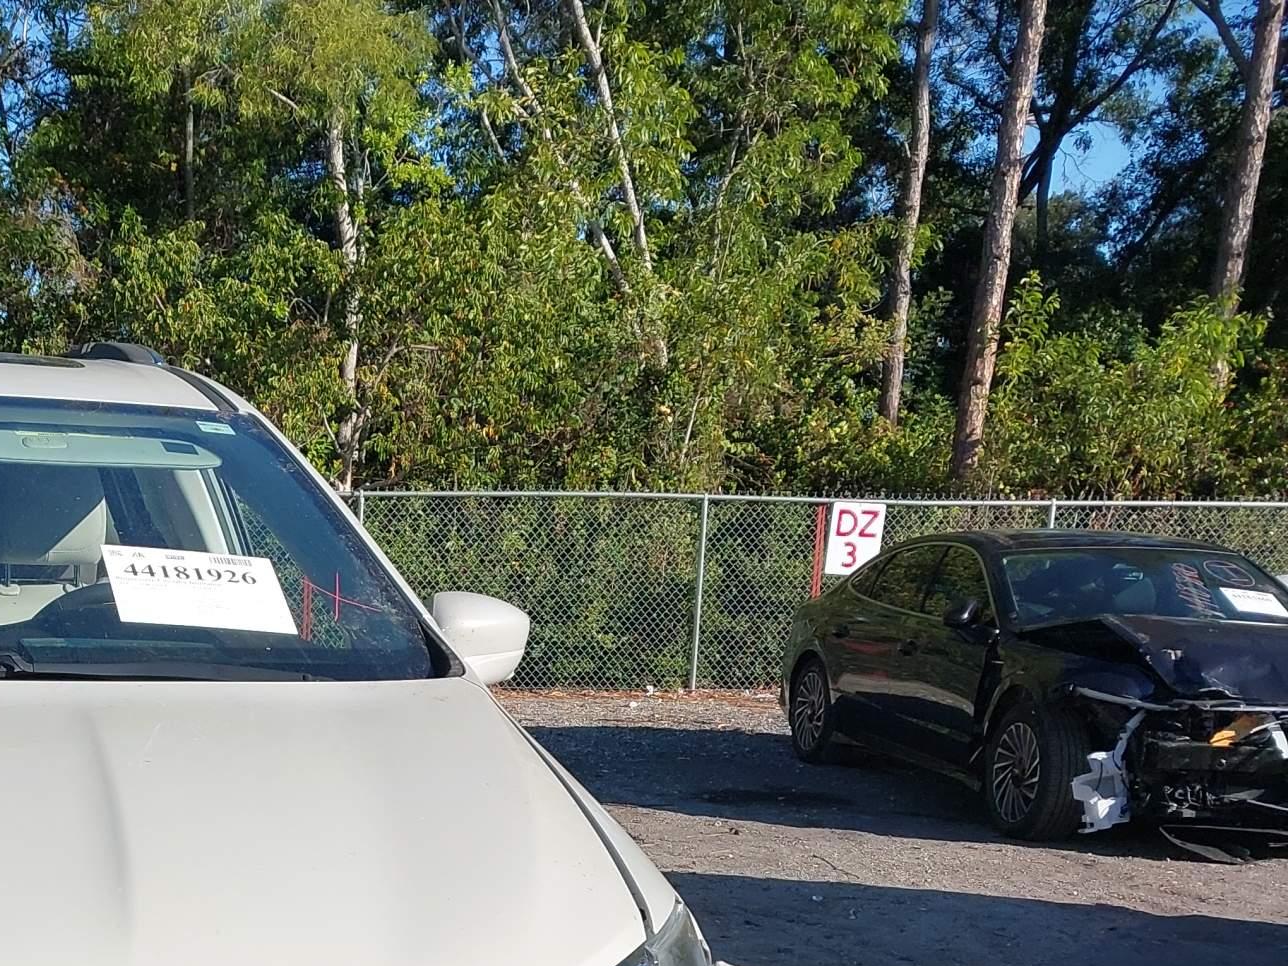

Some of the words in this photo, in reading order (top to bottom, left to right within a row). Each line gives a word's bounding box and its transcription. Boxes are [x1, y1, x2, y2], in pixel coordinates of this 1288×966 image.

[835, 508, 881, 538] DZ
[841, 541, 858, 568] 3
[123, 562, 258, 585] 44181926
